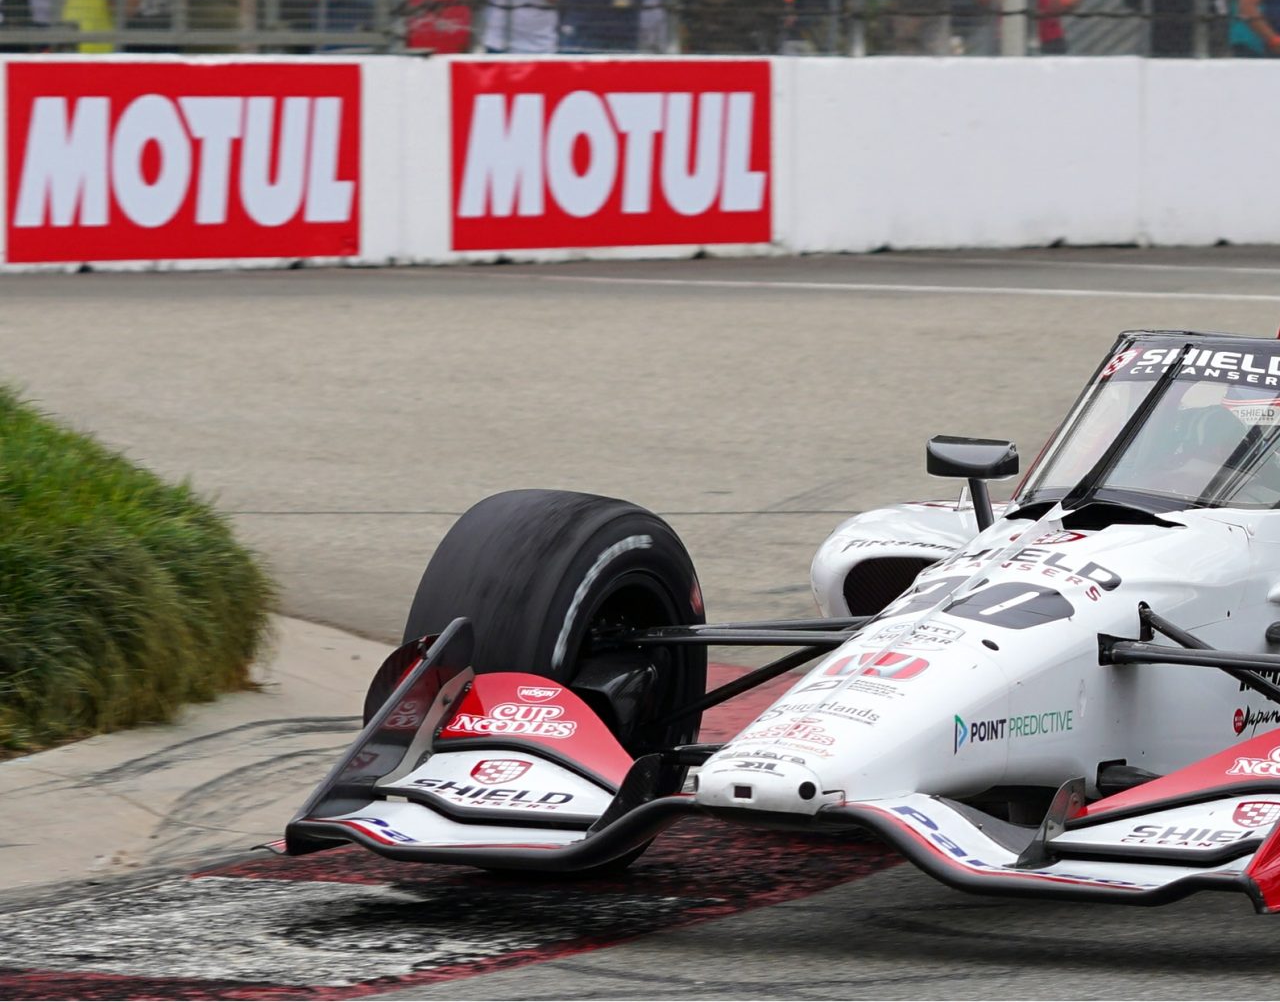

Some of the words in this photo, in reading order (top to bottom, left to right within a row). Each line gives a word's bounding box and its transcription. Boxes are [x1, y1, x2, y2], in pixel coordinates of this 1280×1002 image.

[13, 94, 355, 227] MOTUL
[458, 90, 767, 218] MOTUL
[1240, 408, 1275, 418] SHIELD
[930, 547, 1122, 592] HIELD
[917, 624, 957, 636] NTT
[453, 714, 573, 737] NOODLES
[500, 703, 562, 722] CUP
[970, 719, 1006, 743] POINT
[1008, 709, 1073, 736] PREDICTIVE
[413, 779, 574, 805] SHIELD
